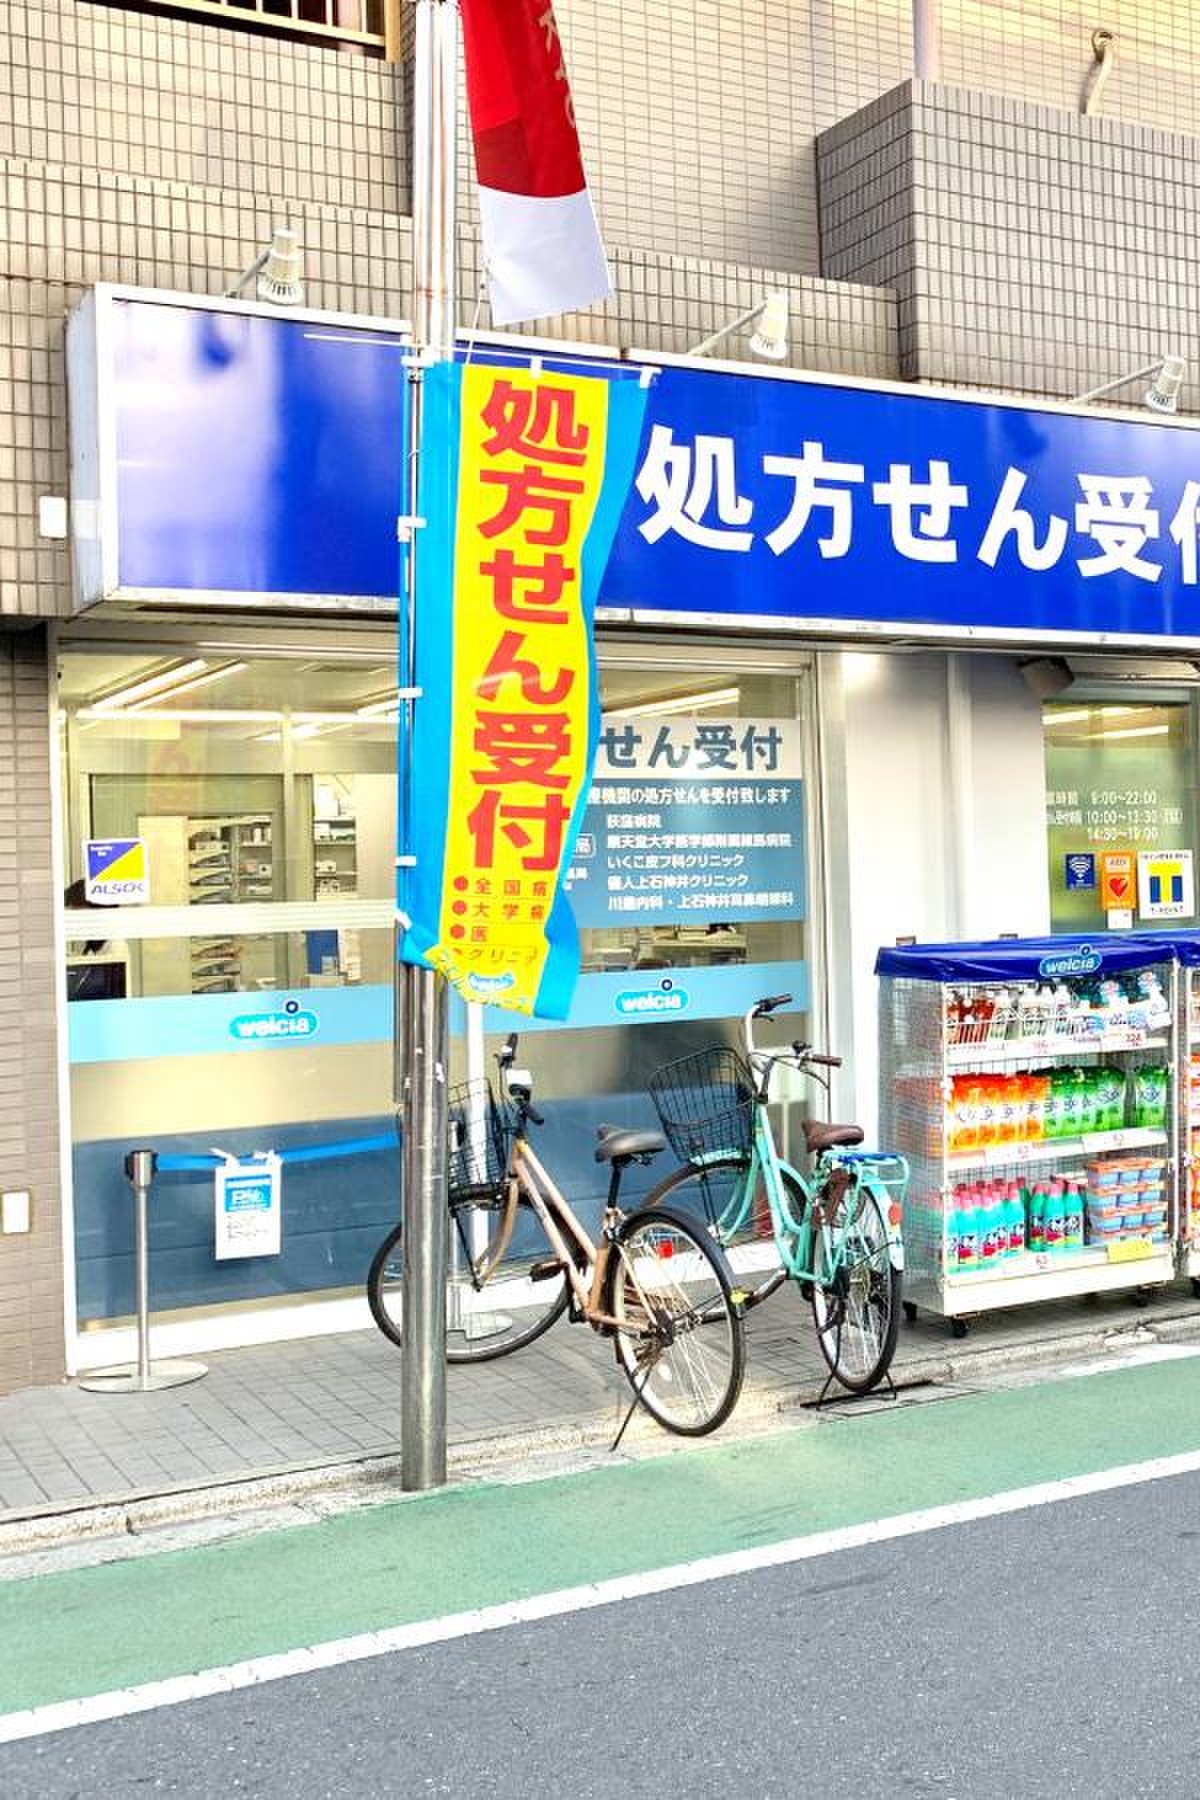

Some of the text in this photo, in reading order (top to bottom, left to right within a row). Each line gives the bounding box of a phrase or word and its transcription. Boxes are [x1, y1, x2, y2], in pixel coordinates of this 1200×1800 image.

[467, 380, 589, 871] 処方せん受付
[600, 726, 783, 771] せん受付
[90, 882, 145, 896] ALSOK
[622, 991, 682, 1013] welcia
[237, 1015, 310, 1038] welcia
